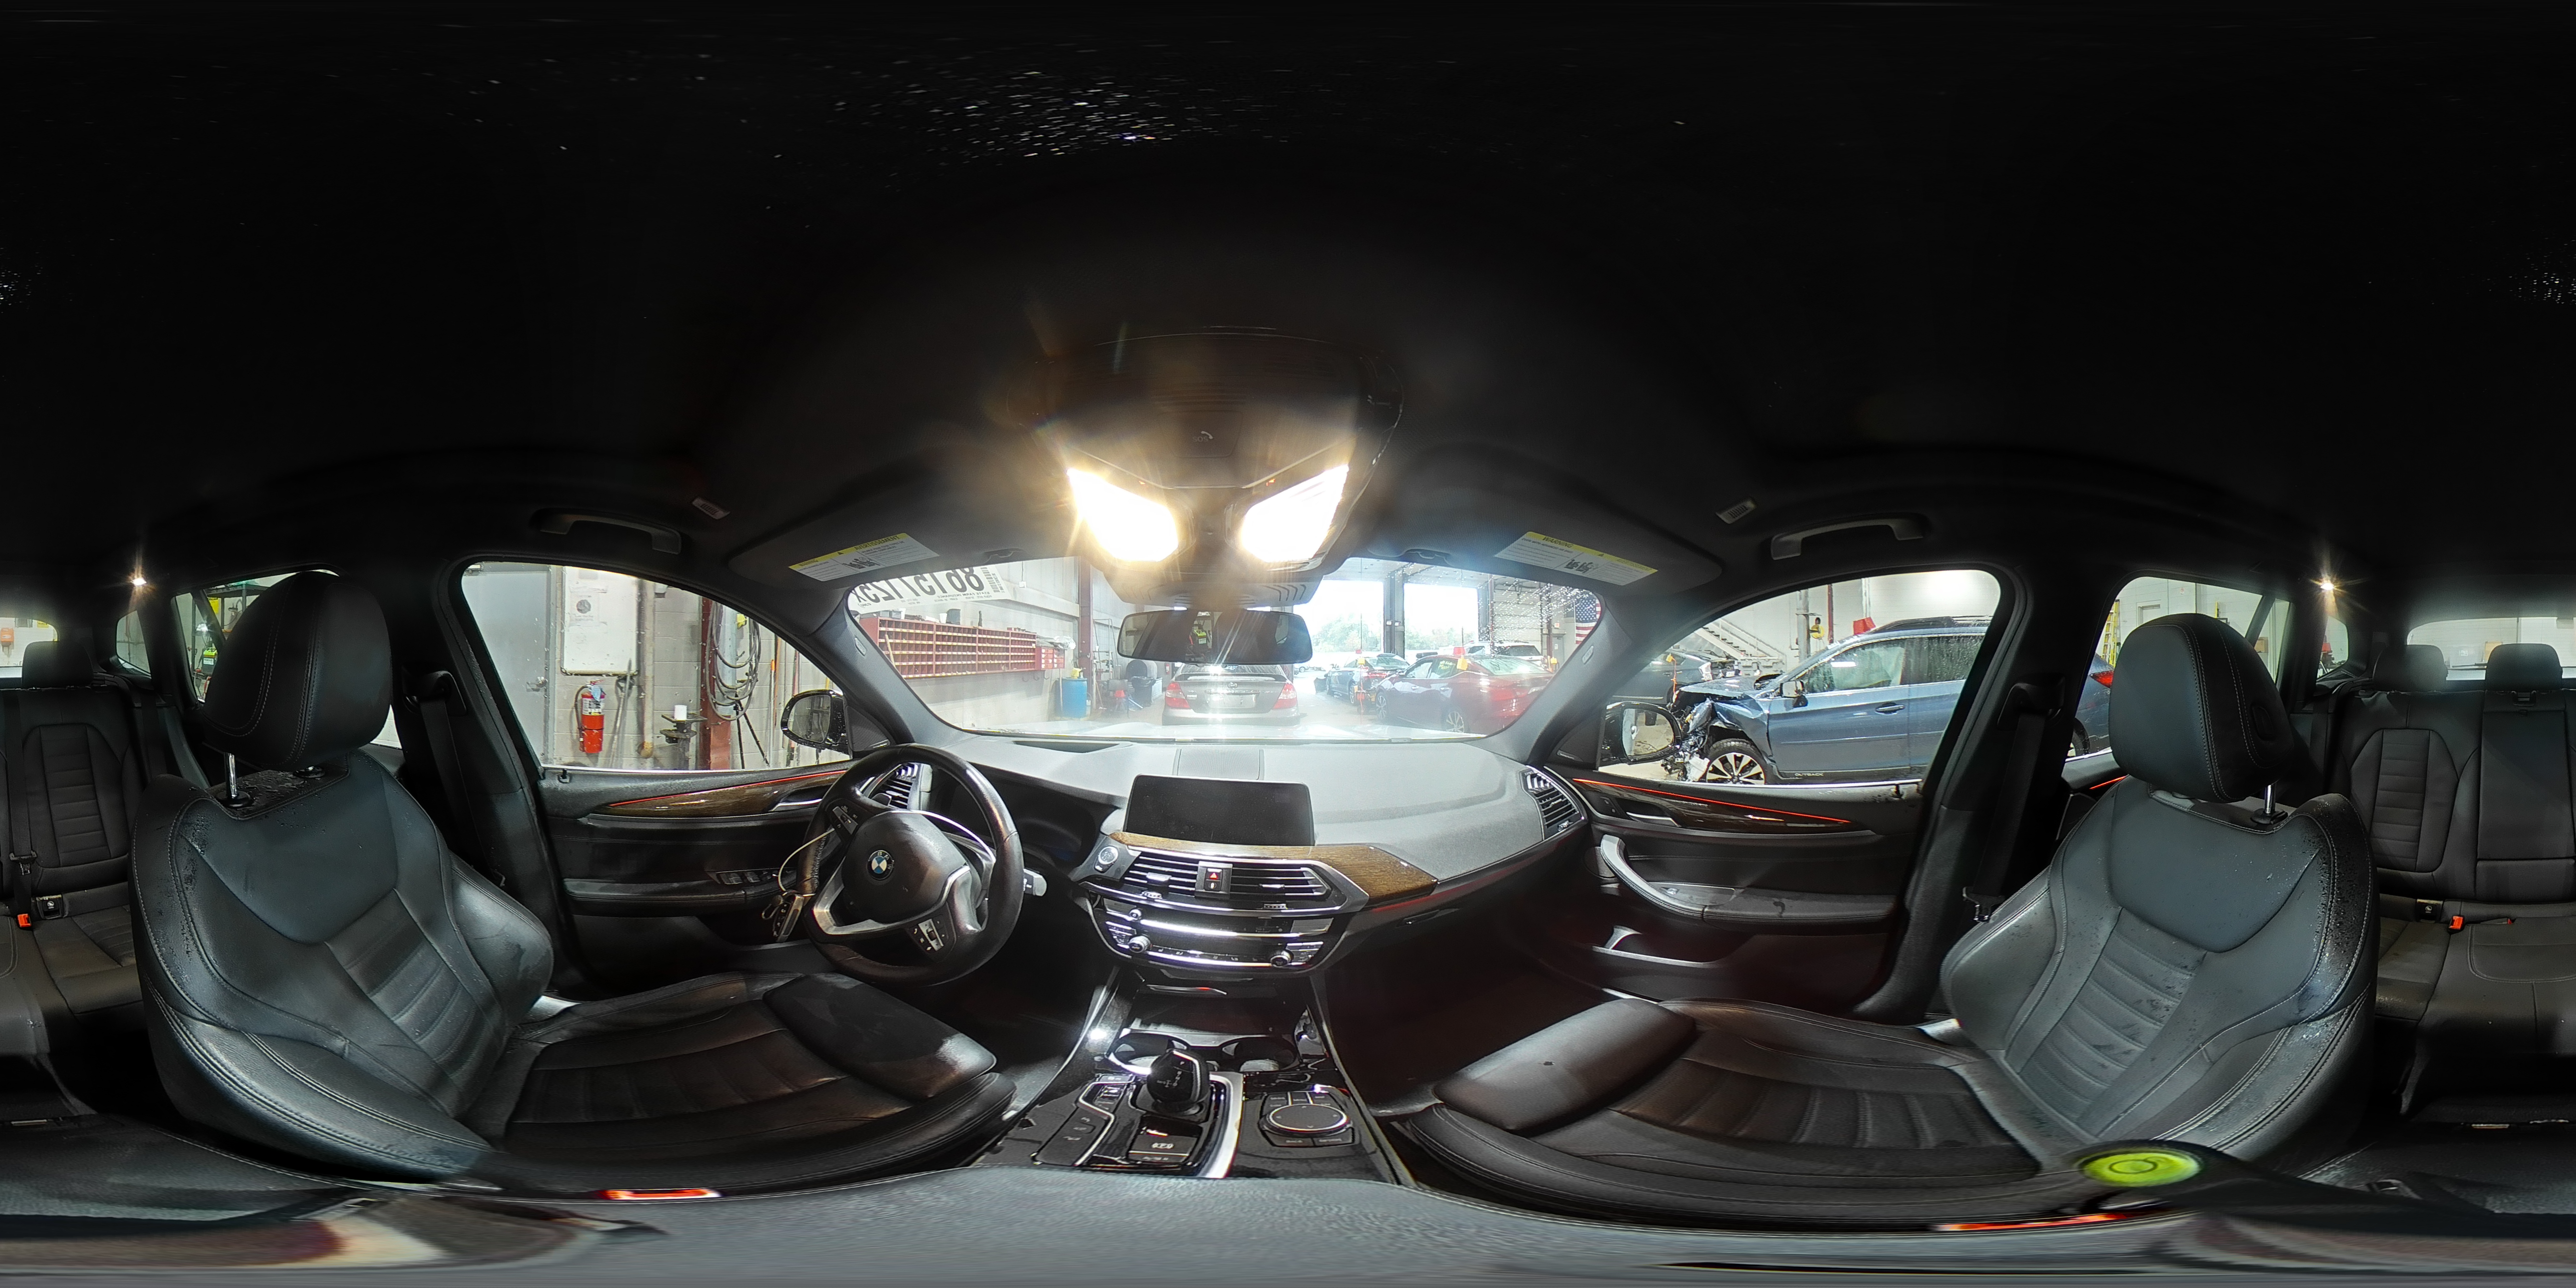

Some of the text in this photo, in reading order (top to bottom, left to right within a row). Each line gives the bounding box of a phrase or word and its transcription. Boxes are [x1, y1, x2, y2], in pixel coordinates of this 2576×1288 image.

[854, 536, 900, 551] AVERTISSEMENT
[1542, 537, 1574, 548] WARNING
[877, 851, 892, 870] BMW
